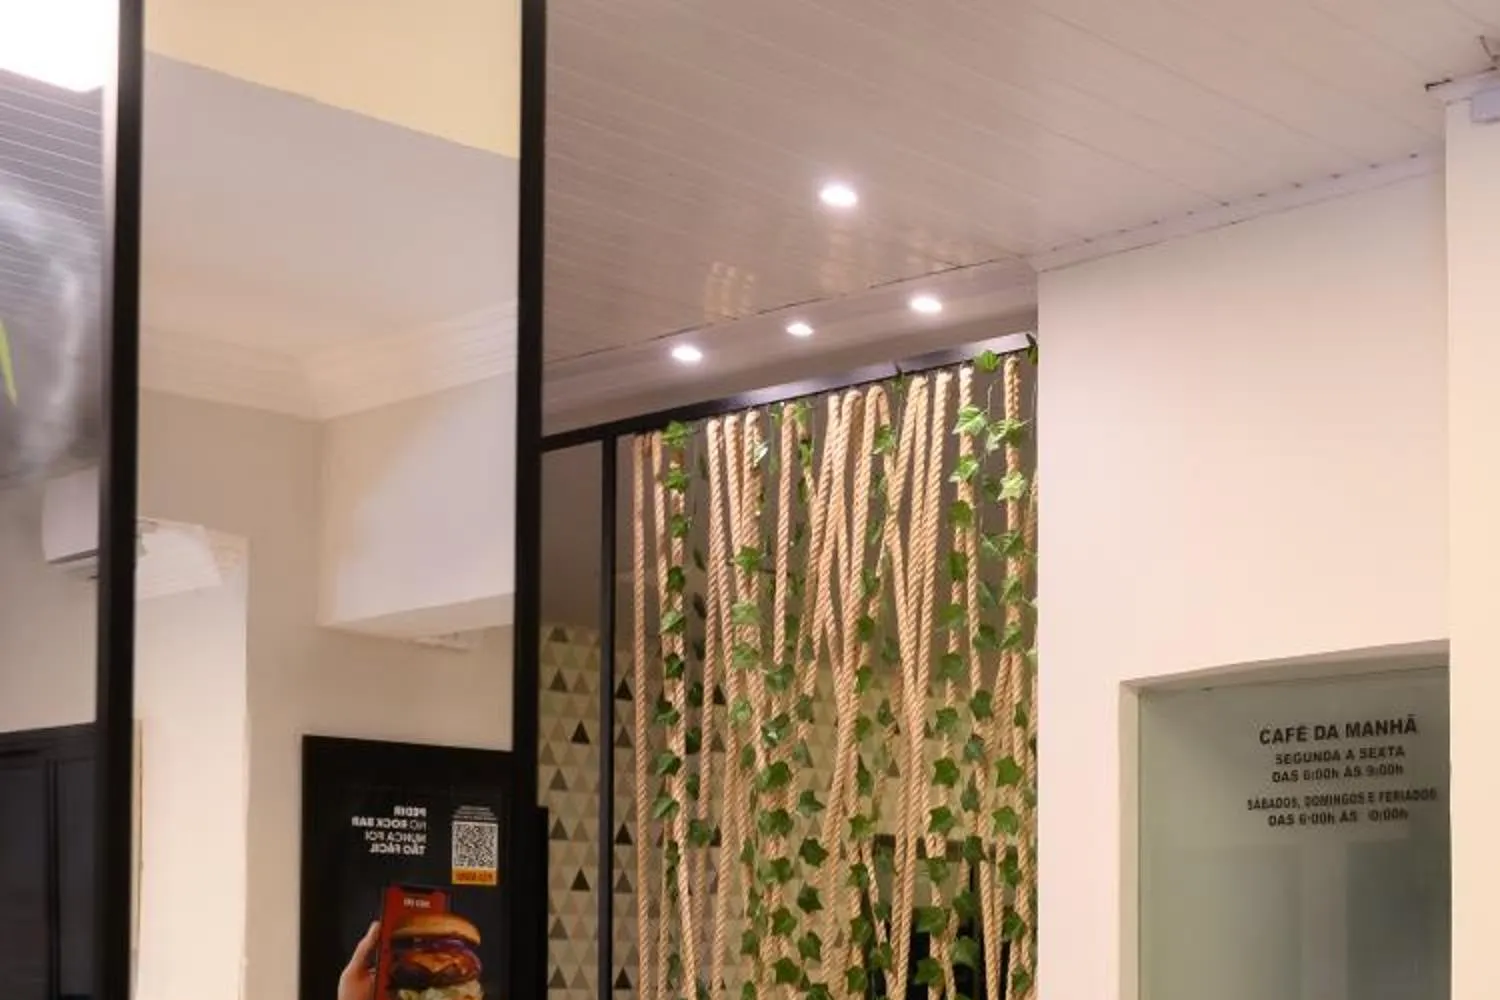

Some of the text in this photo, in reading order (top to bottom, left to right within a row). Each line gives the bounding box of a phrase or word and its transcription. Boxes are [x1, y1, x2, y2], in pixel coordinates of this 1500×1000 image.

[1314, 724, 1339, 741] DA
[1345, 713, 1418, 738] MANHÃ
[1275, 745, 1406, 765] SEGUNDA A SEXTA
[1271, 770, 1299, 783] DAS
[1304, 791, 1365, 808] DOMINGOS
[1367, 791, 1375, 803] E
[1267, 814, 1295, 827] DAS
